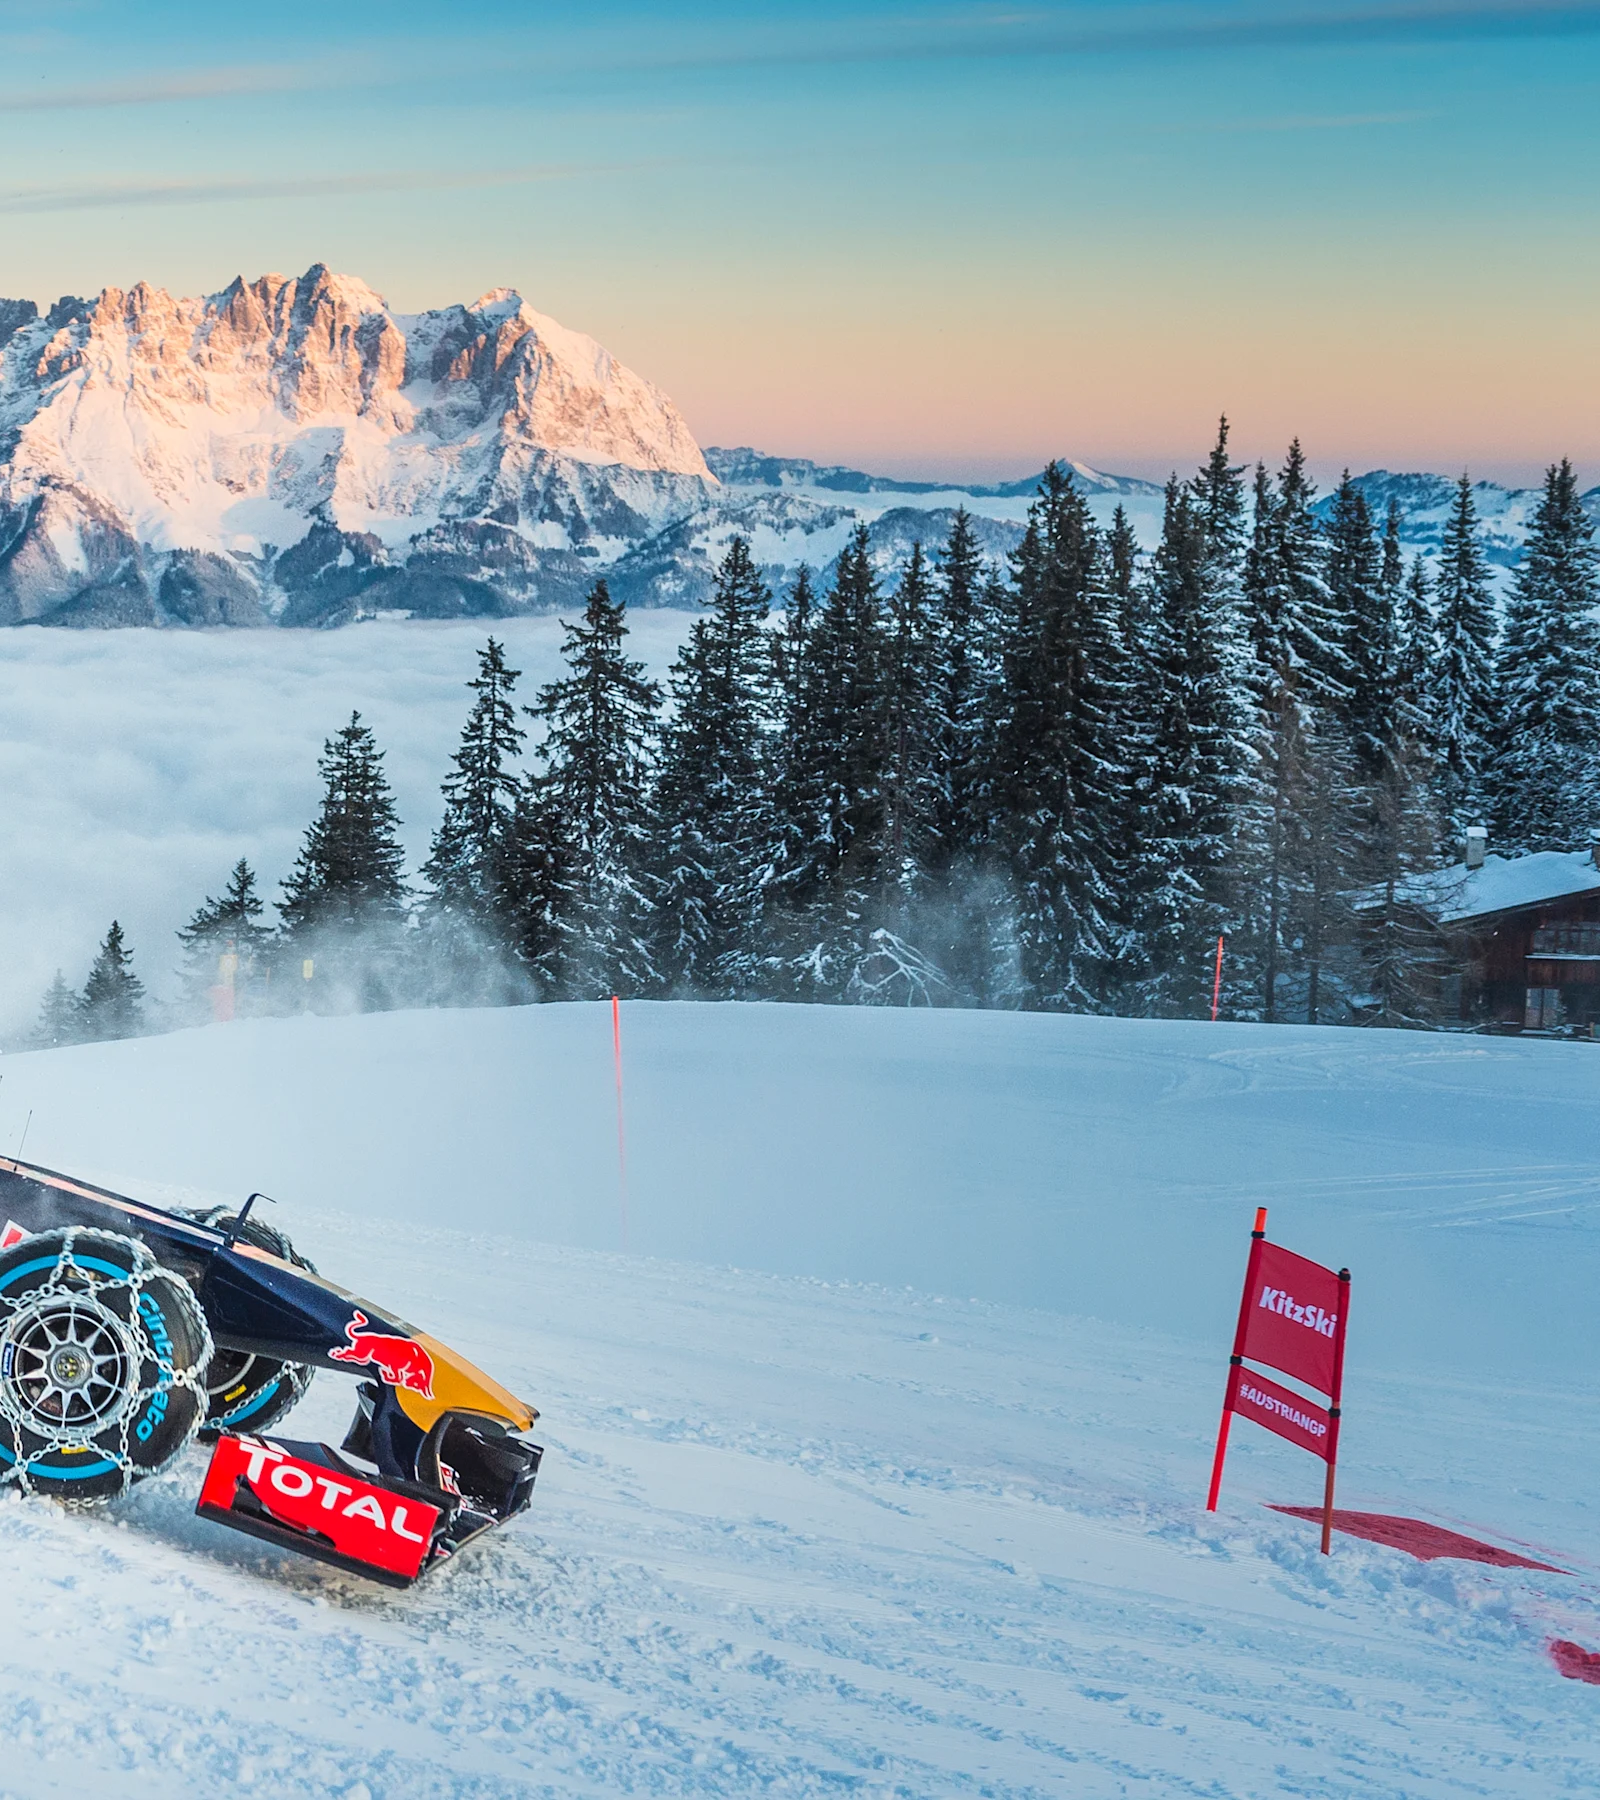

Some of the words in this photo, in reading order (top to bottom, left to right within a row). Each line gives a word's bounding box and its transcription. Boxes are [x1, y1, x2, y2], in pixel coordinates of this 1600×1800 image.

[1259, 1286, 1337, 1338] KitzSki
[1240, 1384, 1326, 1437] #AUSTRIANGP
[239, 1442, 424, 1544] TOTAL
